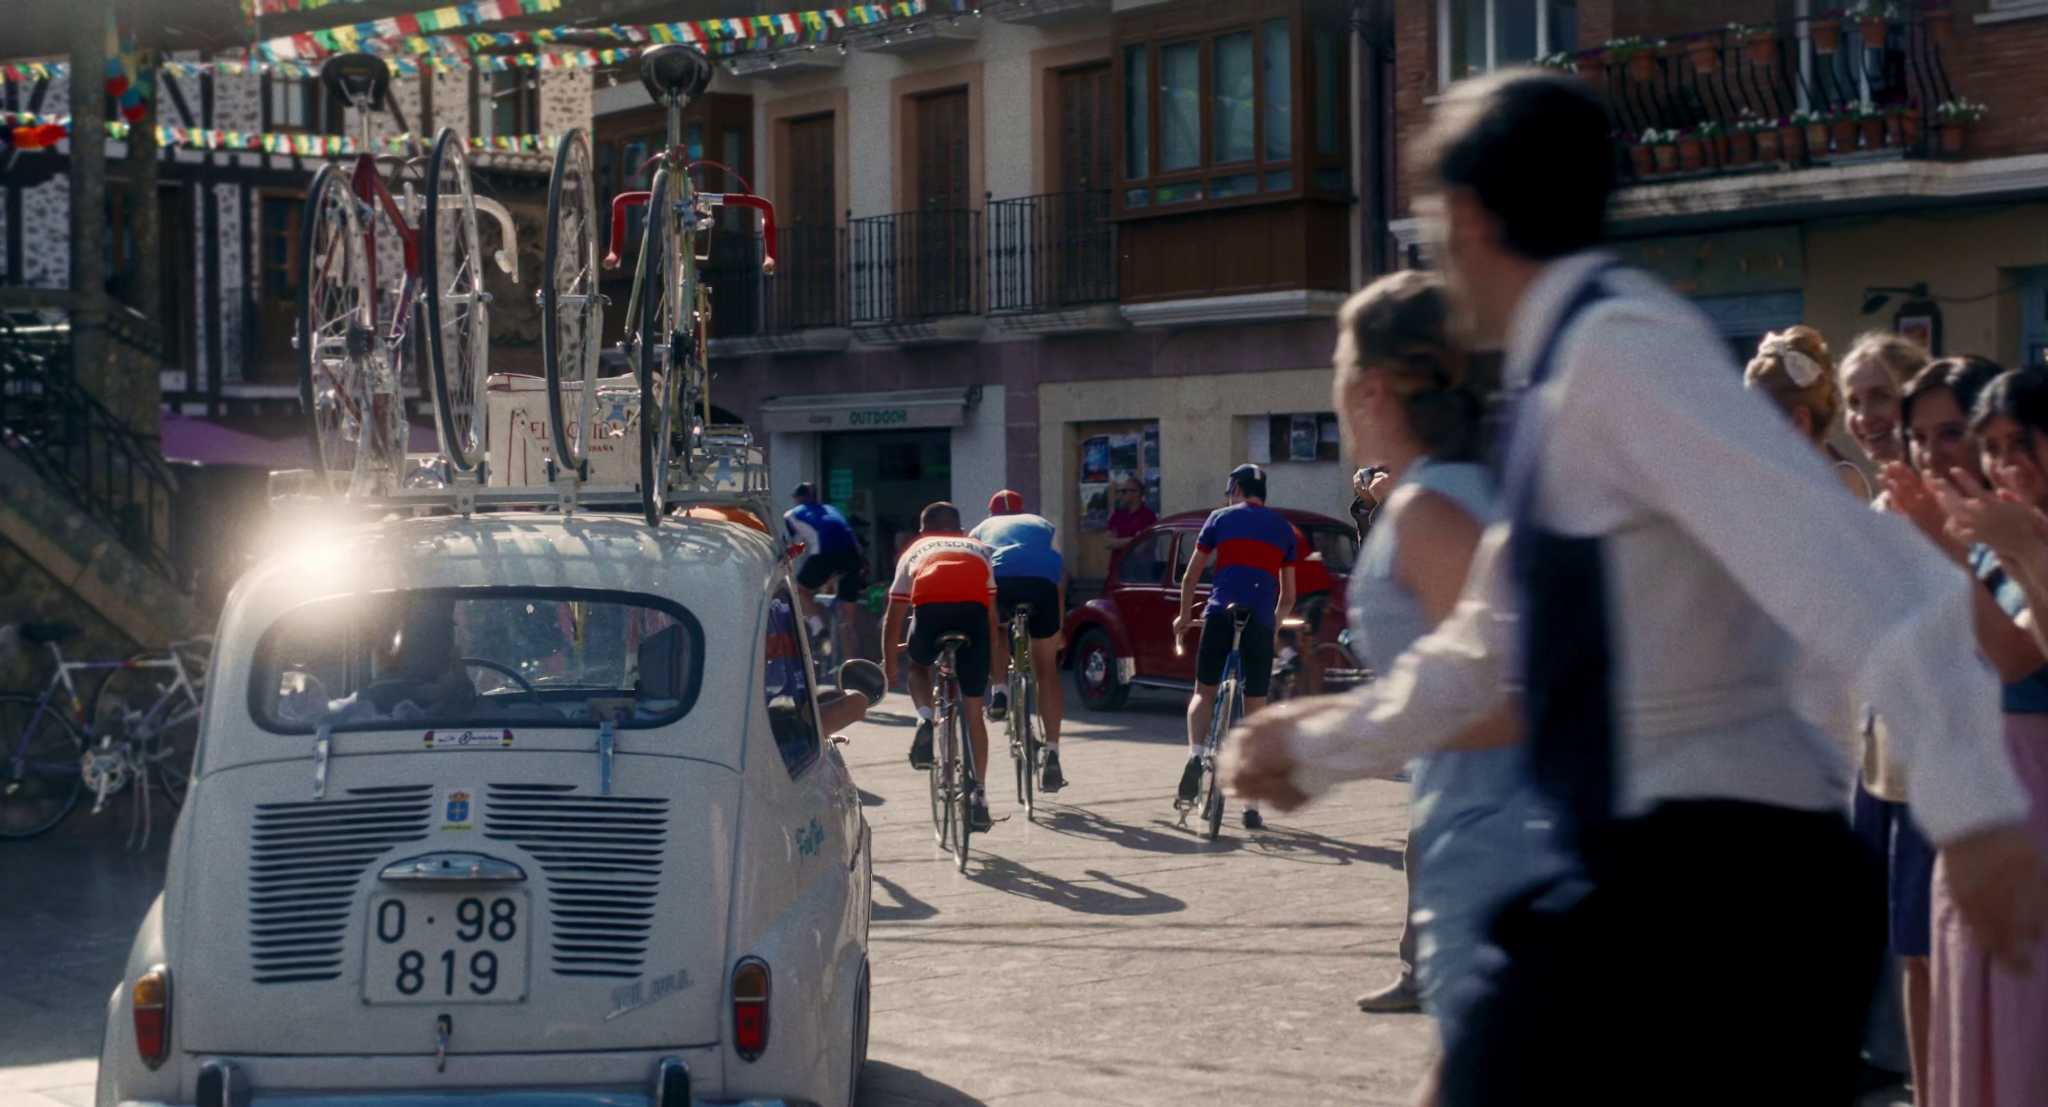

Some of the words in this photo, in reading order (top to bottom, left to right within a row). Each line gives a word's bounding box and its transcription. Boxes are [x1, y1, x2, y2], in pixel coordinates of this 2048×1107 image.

[850, 409, 908, 425] OUTDOOR
[456, 897, 517, 943] 98
[395, 950, 499, 996] 819
